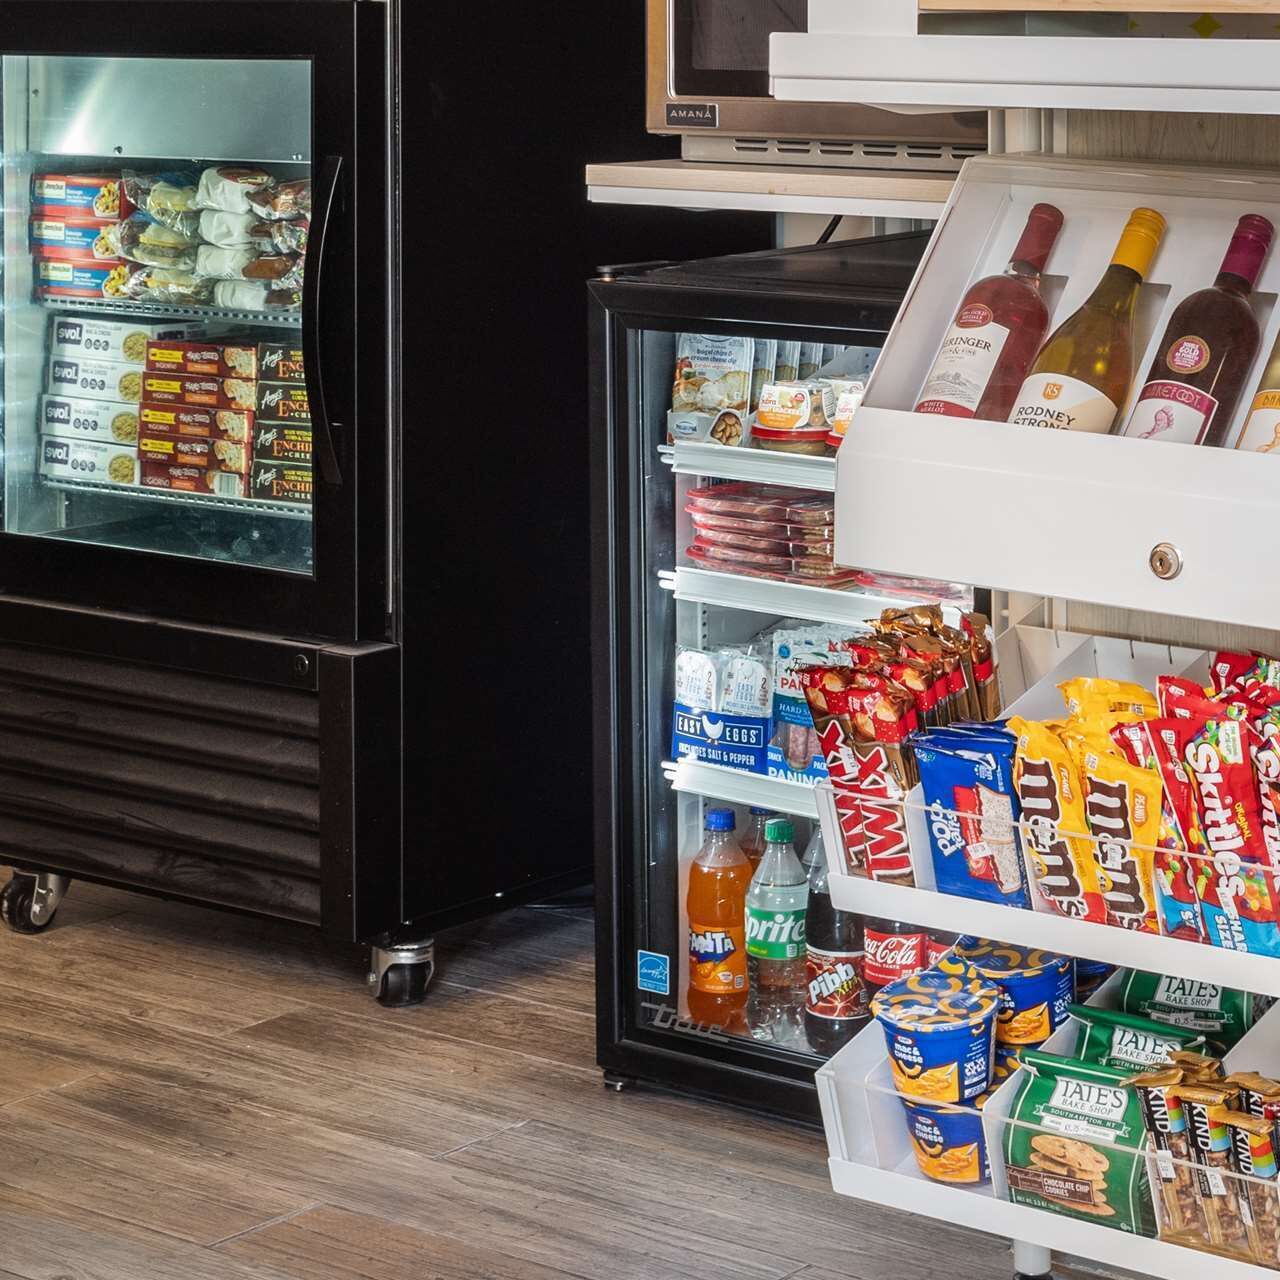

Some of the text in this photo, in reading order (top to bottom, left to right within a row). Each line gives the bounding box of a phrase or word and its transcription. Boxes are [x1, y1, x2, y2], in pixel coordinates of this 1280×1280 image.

[669, 108, 713, 120] AMANA
[262, 349, 284, 370] Amy's
[1180, 345, 1200, 356] GOLD
[261, 389, 284, 409] Amy's
[1045, 382, 1059, 396] RS
[1016, 406, 1077, 426] RODNEY
[257, 428, 278, 449] Amy's
[256, 468, 277, 488] Amy's
[761, 677, 767, 689] 2
[779, 703, 803, 715] HARD
[678, 715, 757, 744] EASY EGGS
[707, 748, 755, 767] SALT & PEPPER
[1060, 766, 1073, 802] PEANUT
[1133, 791, 1147, 824] PEANUT
[1185, 741, 1246, 898] Skittles
[808, 961, 856, 1005] Pibb
[1164, 975, 1220, 999] TATE'S
[1165, 995, 1212, 1007] BAKE SHOP
[912, 1047, 920, 1056] &
[1117, 1048, 1169, 1064] BAKE SHOP
[1060, 1079, 1124, 1109] TATE'S
[1061, 1099, 1114, 1116] BAKE SHOP
[1148, 1087, 1171, 1133] KIND
[933, 1126, 941, 1135] &
[1191, 1102, 1212, 1151] KIND
[1236, 1128, 1255, 1175] KIND
[1043, 1177, 1090, 1193] CHOCOLATE CHIP
[1044, 1186, 1070, 1197] COOKIES
